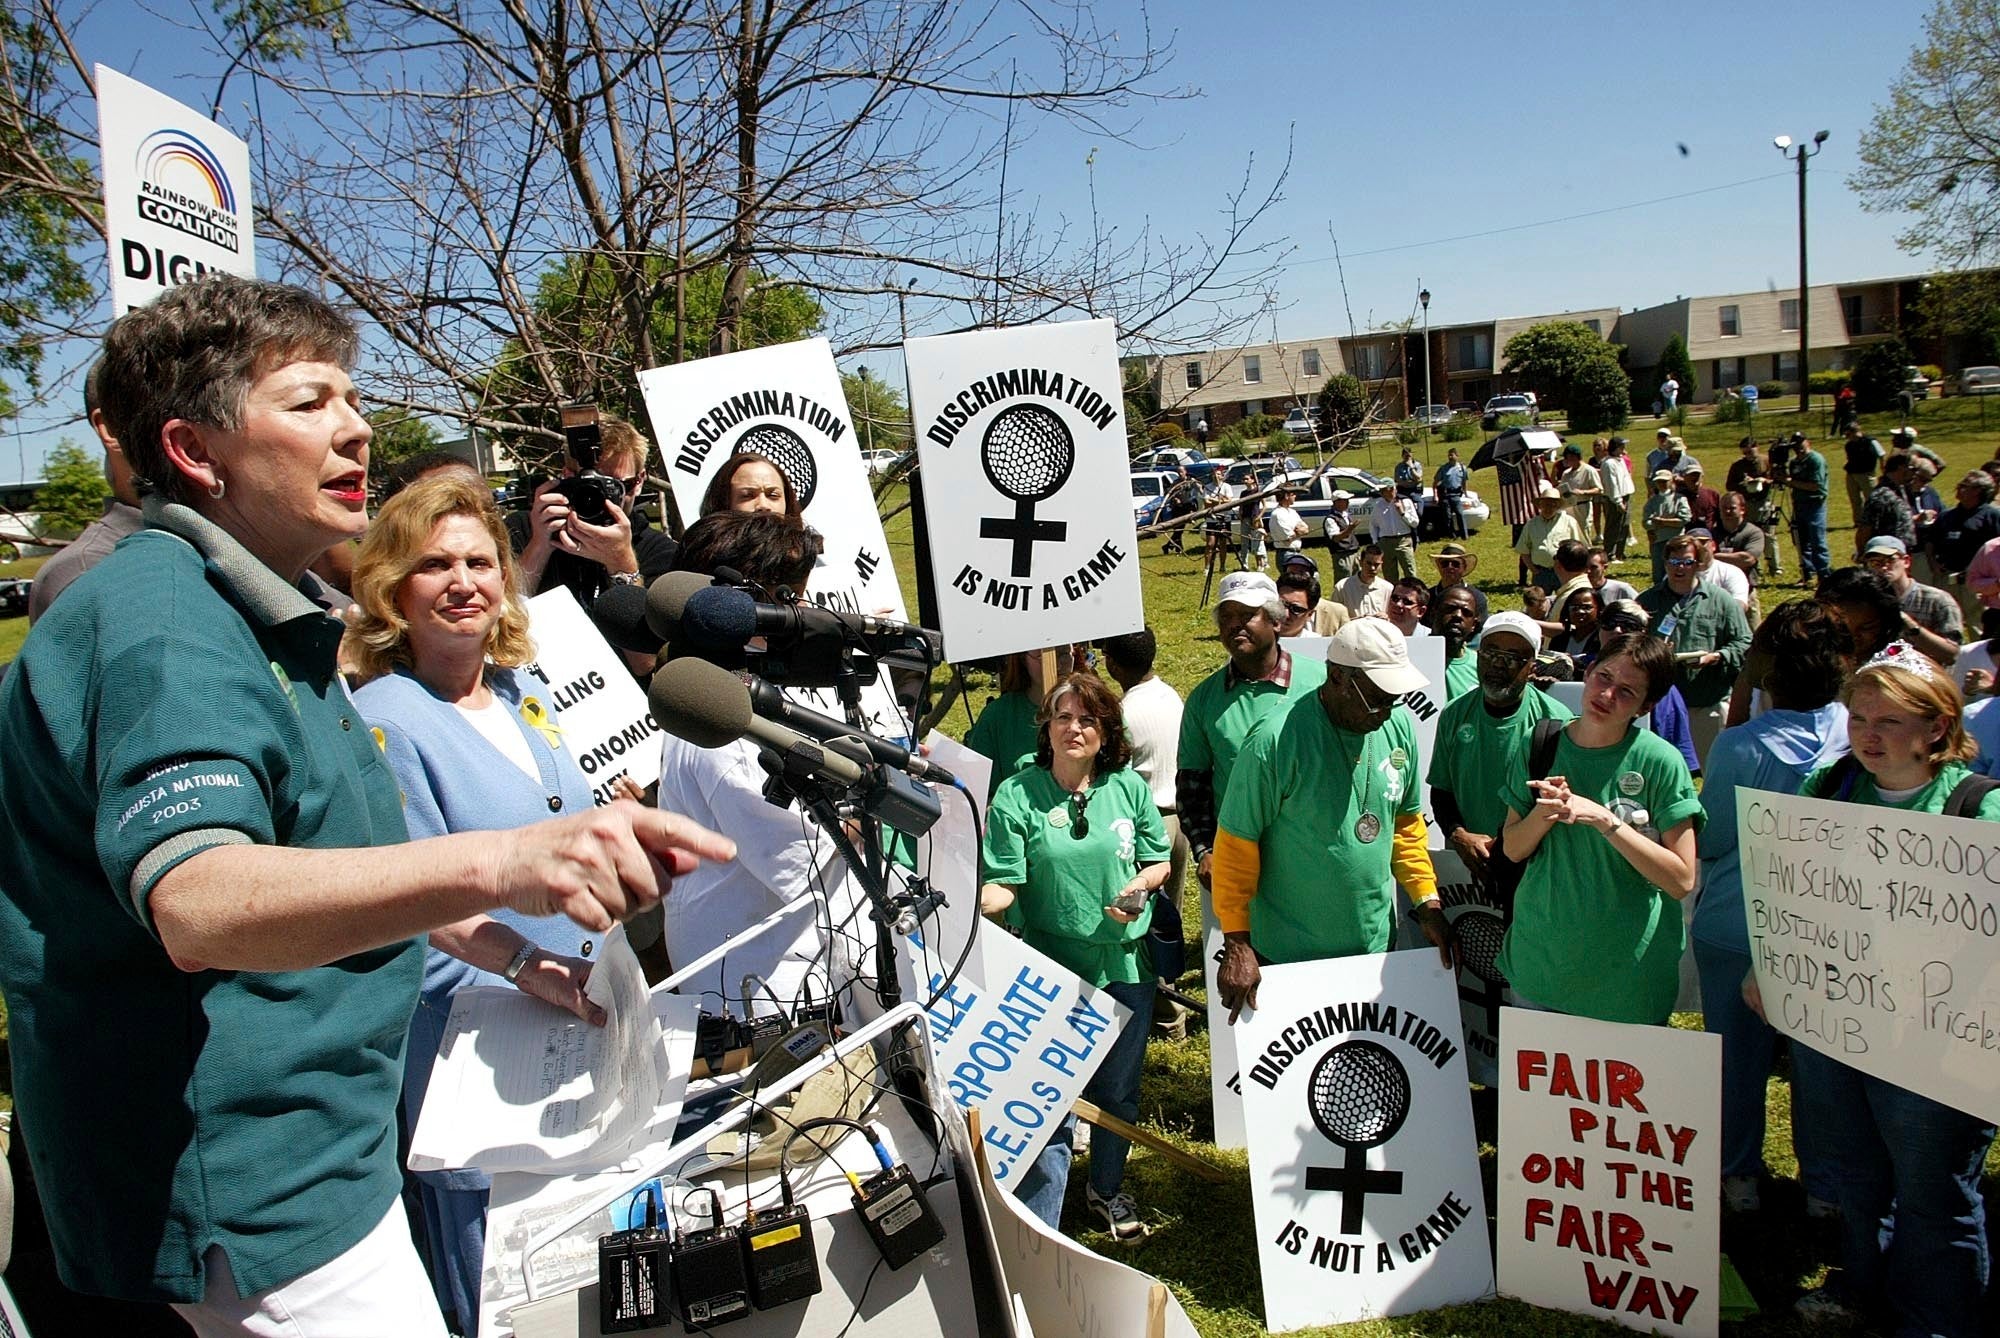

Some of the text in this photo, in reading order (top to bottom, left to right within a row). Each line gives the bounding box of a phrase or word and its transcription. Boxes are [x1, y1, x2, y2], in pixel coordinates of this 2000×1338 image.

[141, 200, 237, 250] COALITION
[142, 181, 207, 214] RAINBOW
[121, 238, 222, 287] DIG
[674, 390, 847, 477] DISCRIMINATION
[926, 369, 1117, 449] DISCRIMINATION
[952, 539, 1126, 611] IS NOT A GAME
[554, 671, 605, 712] LING
[579, 713, 662, 774] ONOMIC
[117, 774, 244, 832] AUGUSTA NATIONAL
[152, 797, 202, 824] 2003
[1752, 899, 1871, 962] BUSTING UP
[1886, 879, 1998, 937] $124,000
[1753, 935, 1782, 979] THE
[1784, 953, 1819, 990] OLD
[947, 965, 1062, 1108] RPORATE
[1039, 994, 1111, 1078] PLAY
[1249, 1002, 1458, 1090] DISCRIMINATION
[1783, 993, 1869, 1054] CLUB
[1517, 1050, 1648, 1113] FAIR
[1570, 1108, 1697, 1166] PLAY
[1522, 1153, 1693, 1211] ON THE
[1275, 1190, 1472, 1274] IS NOT A GAME
[1525, 1198, 1673, 1268] FAIR-
[1583, 1261, 1699, 1324] WAY
